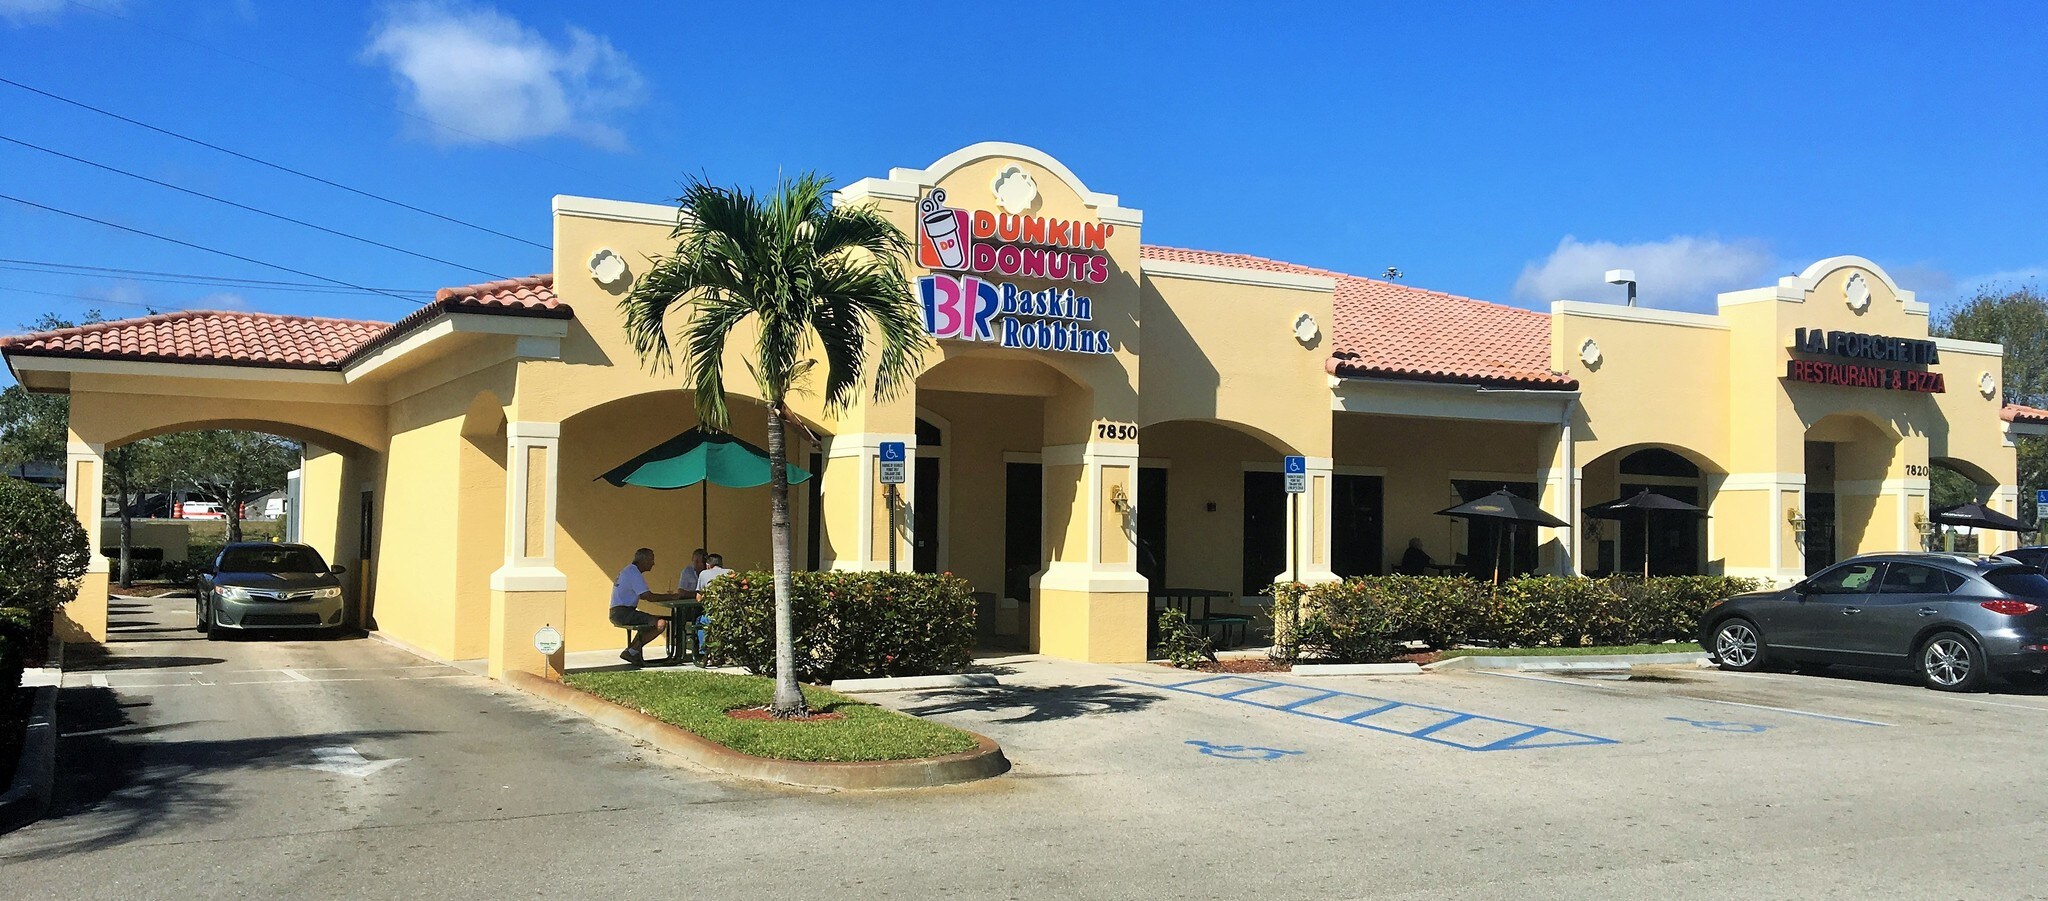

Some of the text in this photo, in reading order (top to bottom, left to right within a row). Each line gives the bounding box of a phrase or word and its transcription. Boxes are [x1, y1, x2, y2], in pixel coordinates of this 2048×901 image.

[939, 239, 955, 251] DD
[973, 209, 1114, 249] DUNKIN'
[973, 243, 1109, 283] DONUTS
[919, 275, 999, 341] BR
[1001, 283, 1092, 320] Baskin
[1798, 328, 1939, 364] LA FORCHETTA
[1794, 360, 1945, 393] RESTAURANT & PIZZA
[1098, 424, 1137, 440] 7850
[1905, 464, 1928, 477] 7820
